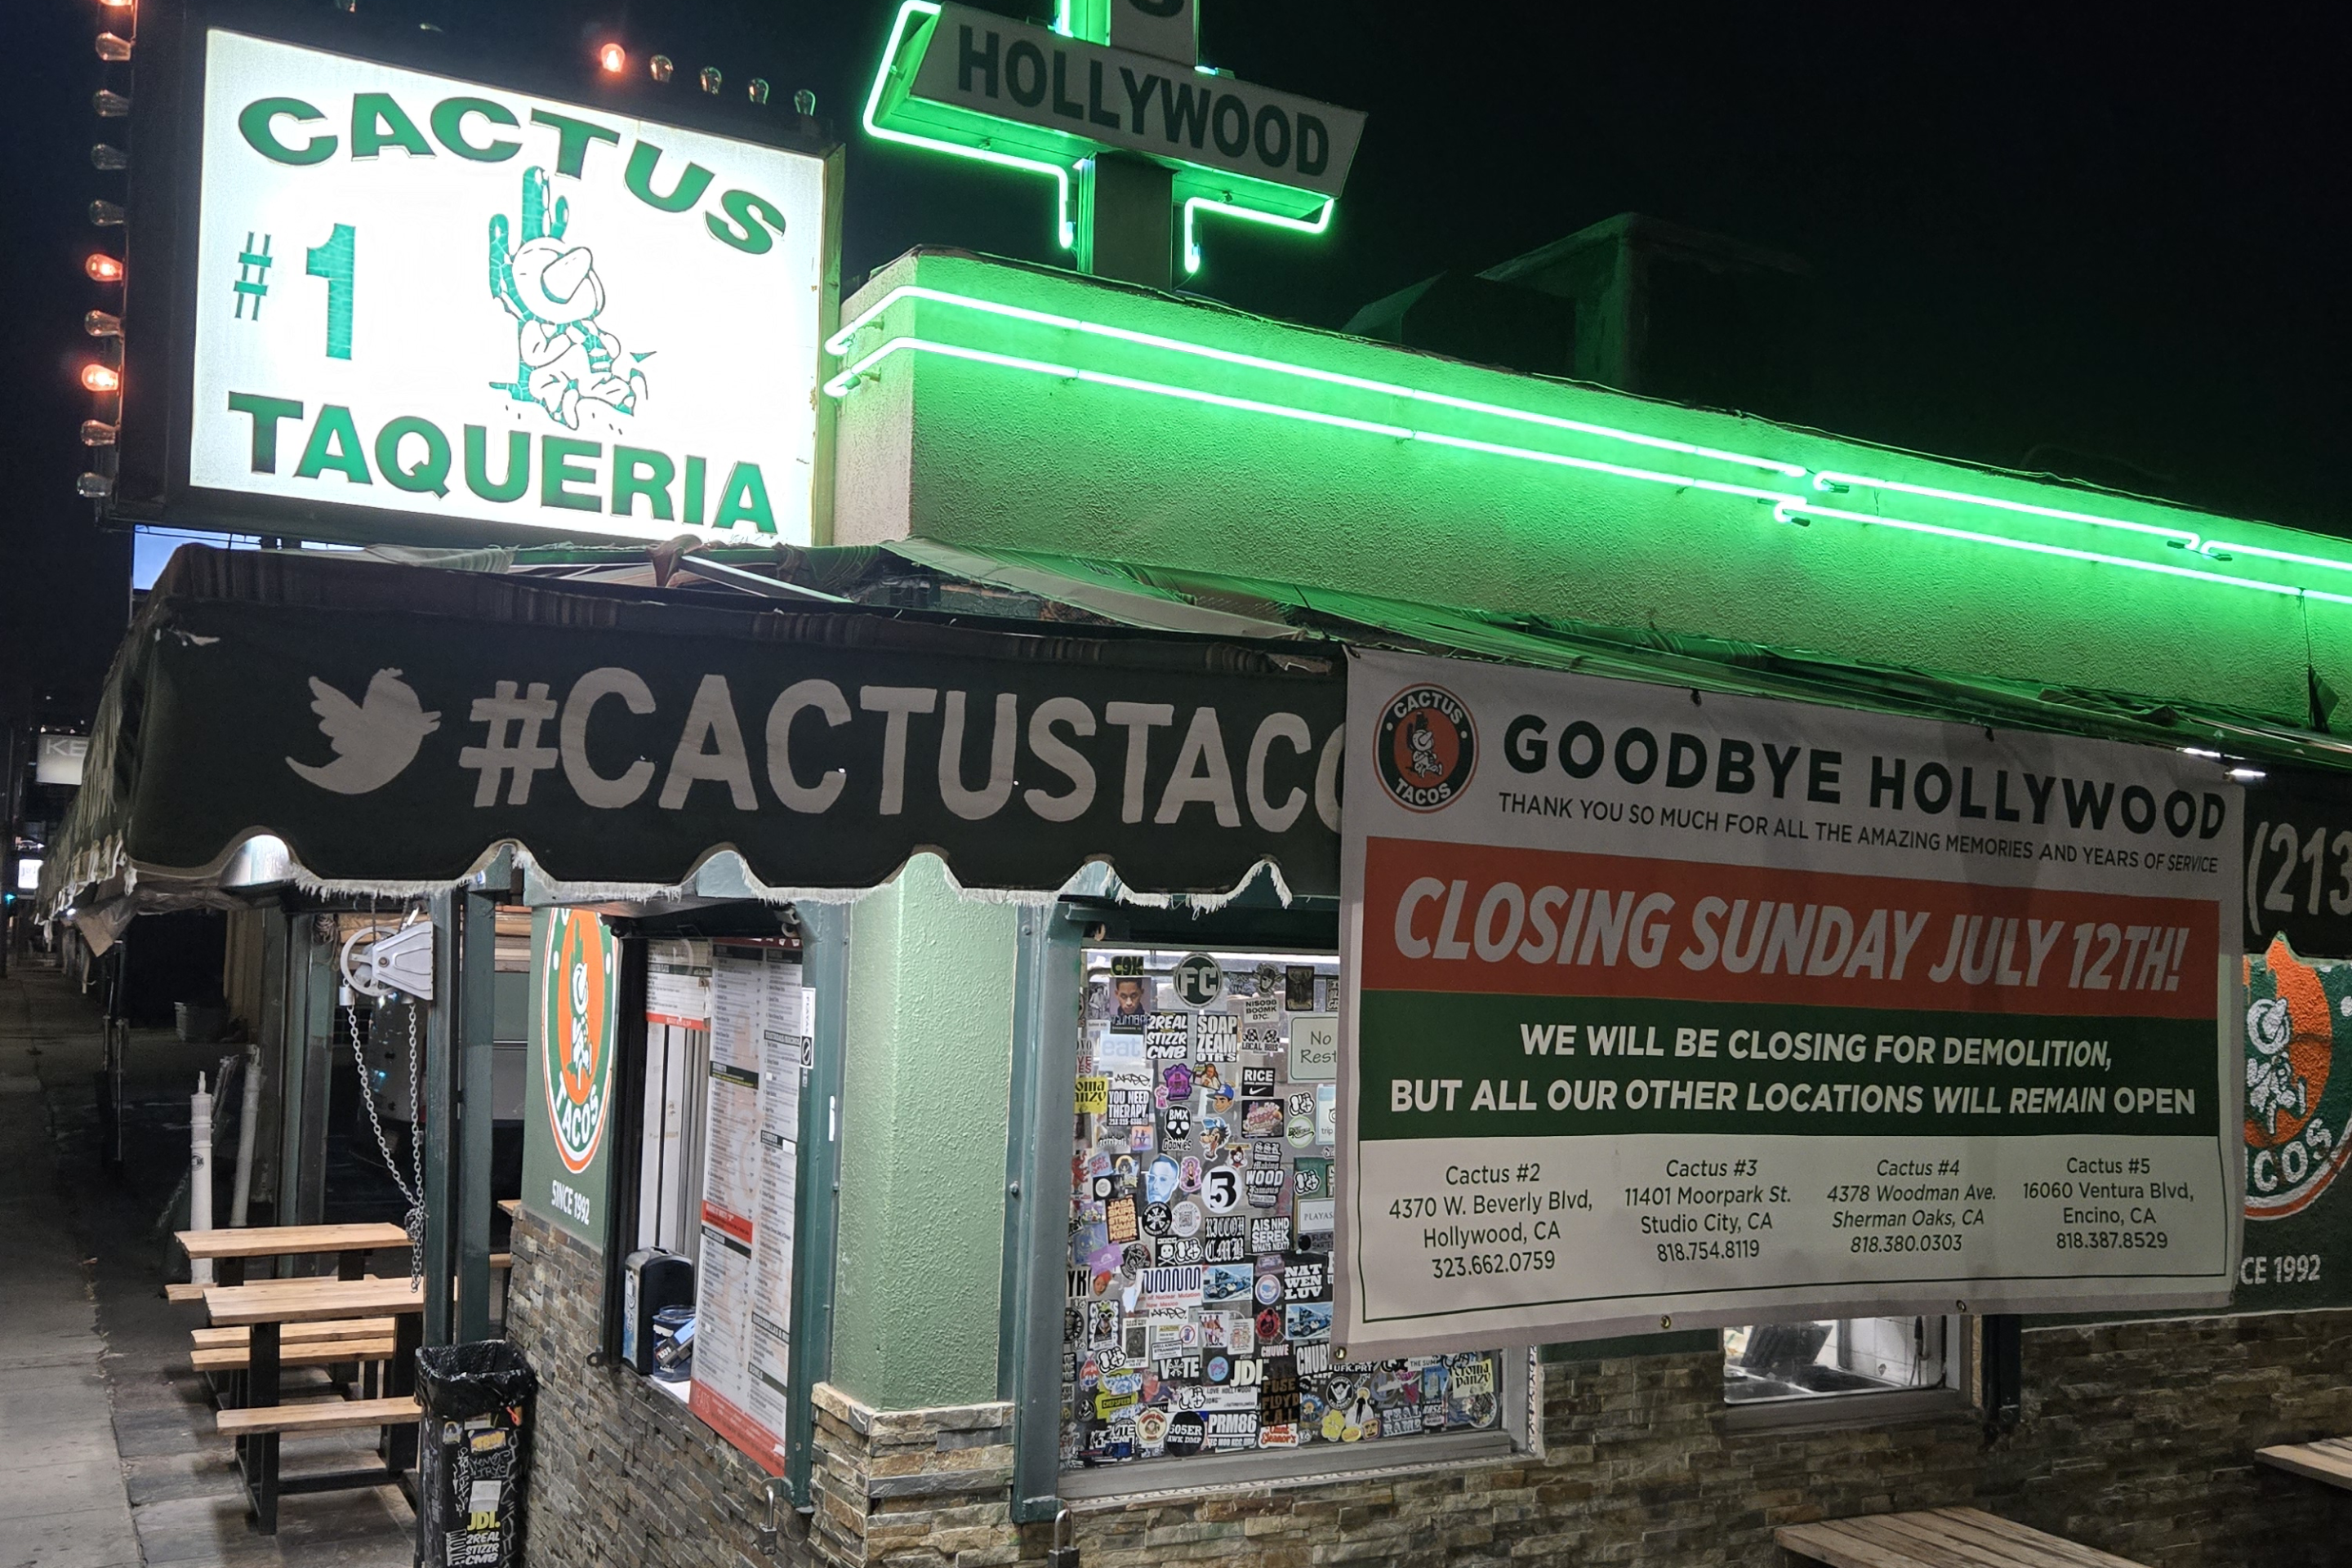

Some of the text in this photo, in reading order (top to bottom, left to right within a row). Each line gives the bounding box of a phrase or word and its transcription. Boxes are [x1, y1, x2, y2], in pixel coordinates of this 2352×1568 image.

[958, 24, 1329, 177] HOLLYWOOD
[238, 92, 786, 256] CACTUS
[228, 392, 778, 535] TAQUERIA
[1393, 690, 1463, 725] CACTUS
[1503, 714, 2226, 840] GOODBYE HOLLYWOOD
[1393, 777, 1451, 806] TACOS
[1499, 791, 2219, 874] THANK YOU SO MUCH FOR ALL THE AMAZING MEMORIES AND YEARS OF SERVICE
[1394, 876, 2190, 992] CLOSING SUNDAY JULY 12TH!
[1197, 1015, 1237, 1034] SOAP
[1102, 1038, 1141, 1057] eat
[1197, 1034, 1237, 1054] ZEAM
[1311, 1031, 1332, 1045] No
[1520, 1023, 2113, 1071] WE WILL BE CLOSING FOR DEMOLITION,
[1147, 1045, 1187, 1059] CMB
[1244, 1069, 1274, 1081] RICE
[1109, 1091, 1149, 1104] YOU NEED
[1391, 1079, 2195, 1115] BUT ALL OUR OTHER LOCATIONS WILL REMAIN OPEN
[555, 1071, 599, 1147] TACOS
[1169, 1109, 1188, 1120] BMX
[2244, 1118, 2332, 1192] COS
[1445, 1163, 1541, 1186] Cactus #2
[1665, 1158, 1757, 1179] Cactus #3
[1876, 1158, 1960, 1178] Cactus #4
[2066, 1156, 2150, 1175] Cactus #5
[1245, 1170, 1284, 1184] WOOD
[1624, 1183, 1792, 1210] 11401 Moorpark St.
[1826, 1183, 1997, 1203] 4378 Woodman Ave.
[2022, 1182, 2194, 1202] 16060 Ventura Blvd,
[551, 1180, 590, 1225] SINCE 1992
[1388, 1188, 1593, 1220] 4370 W. Beverly Blvd,
[1641, 1210, 1773, 1237] Studio City, CA
[1831, 1209, 1984, 1230] Sherman Oaks, CA
[2063, 1207, 2157, 1227] Encino, CA
[1251, 1230, 1290, 1244] SEREK
[1423, 1220, 1561, 1250] Hollywood, CA
[1849, 1234, 1962, 1254] 818.380.0303
[2056, 1231, 2168, 1250] 818.387.8529
[1656, 1239, 1760, 1263] 818.754.8119
[1285, 1264, 1322, 1277] NAT
[1432, 1250, 1556, 1280] 323.662.0759
[2274, 1254, 2321, 1283] 1992
[1285, 1276, 1322, 1289] WEN
[1285, 1286, 1323, 1300] LUV
[1296, 1344, 1330, 1376] CHUB
[1410, 1360, 1421, 1368] THE
[1263, 1378, 1296, 1393] FUSE
[1262, 1392, 1299, 1410] FLOYD
[1208, 1413, 1258, 1434] PRM86
[466, 1531, 501, 1544] 2REAL
[466, 1553, 499, 1566] CMB
